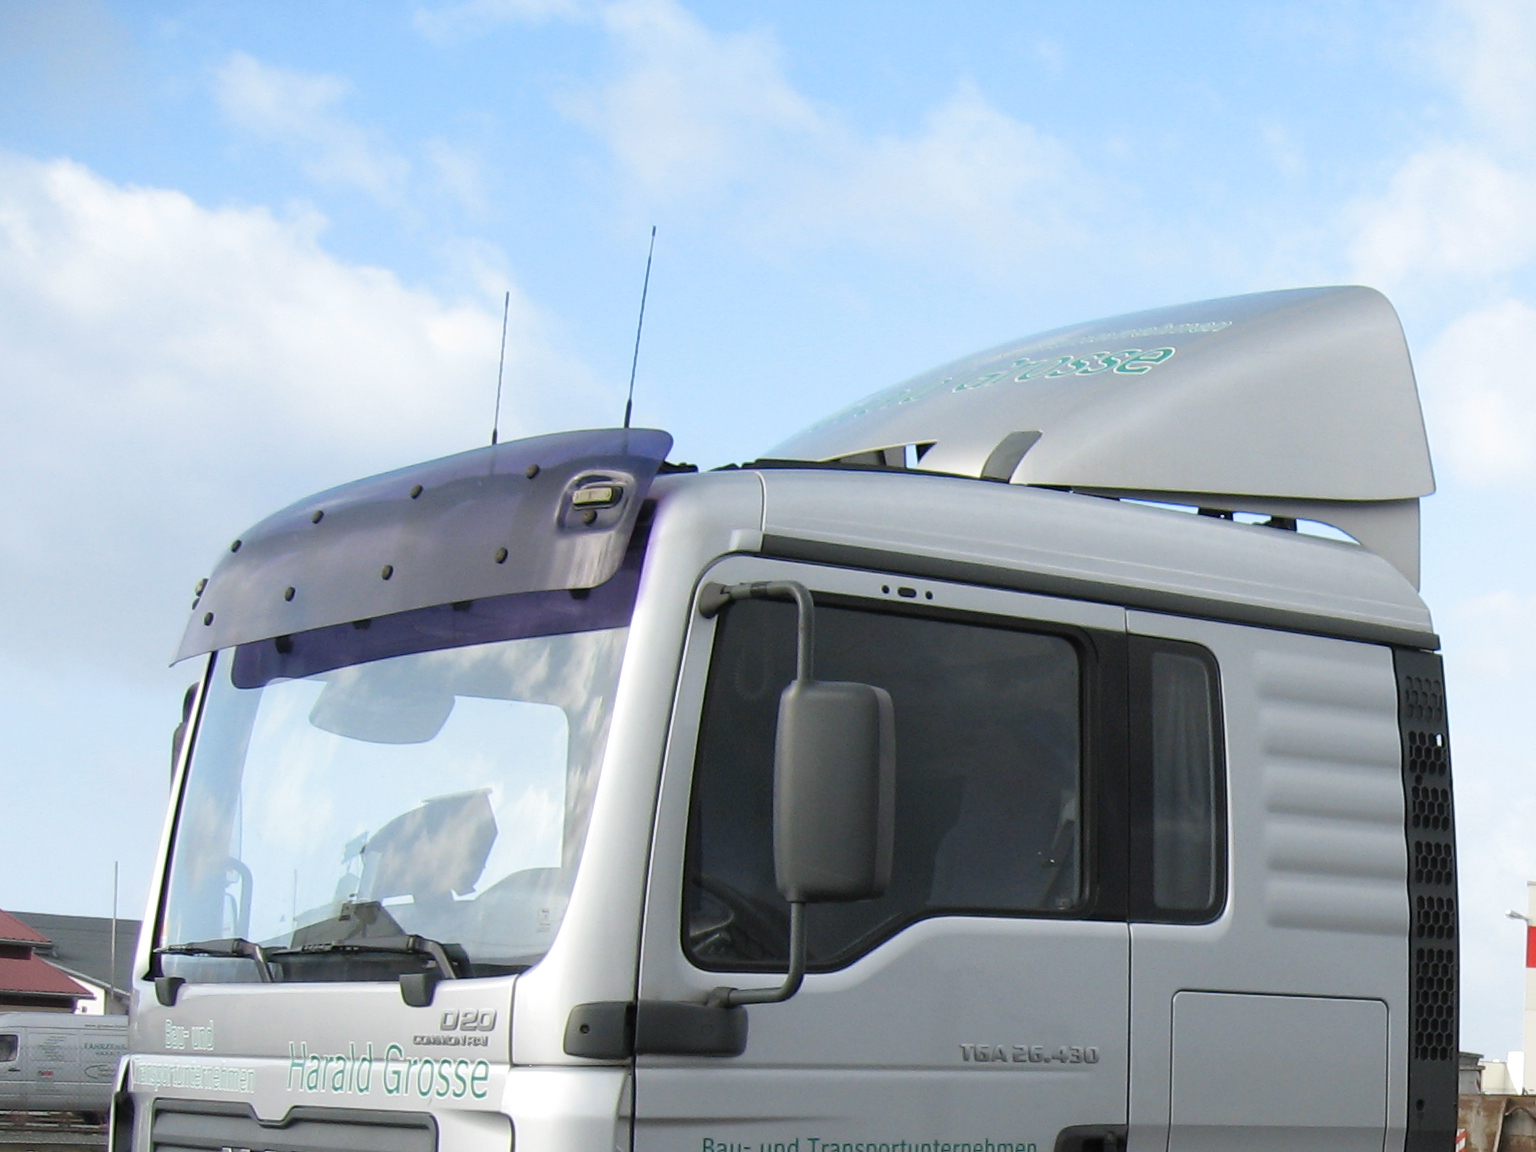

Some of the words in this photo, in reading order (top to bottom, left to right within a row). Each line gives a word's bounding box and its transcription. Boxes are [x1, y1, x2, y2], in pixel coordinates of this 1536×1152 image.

[440, 1008, 497, 1031] D20
[191, 1019, 214, 1050] und
[960, 1043, 1008, 1062] TGA
[1012, 1044, 1099, 1064] 26.430
[286, 1041, 374, 1097] Harald
[382, 1042, 490, 1099] Grosse
